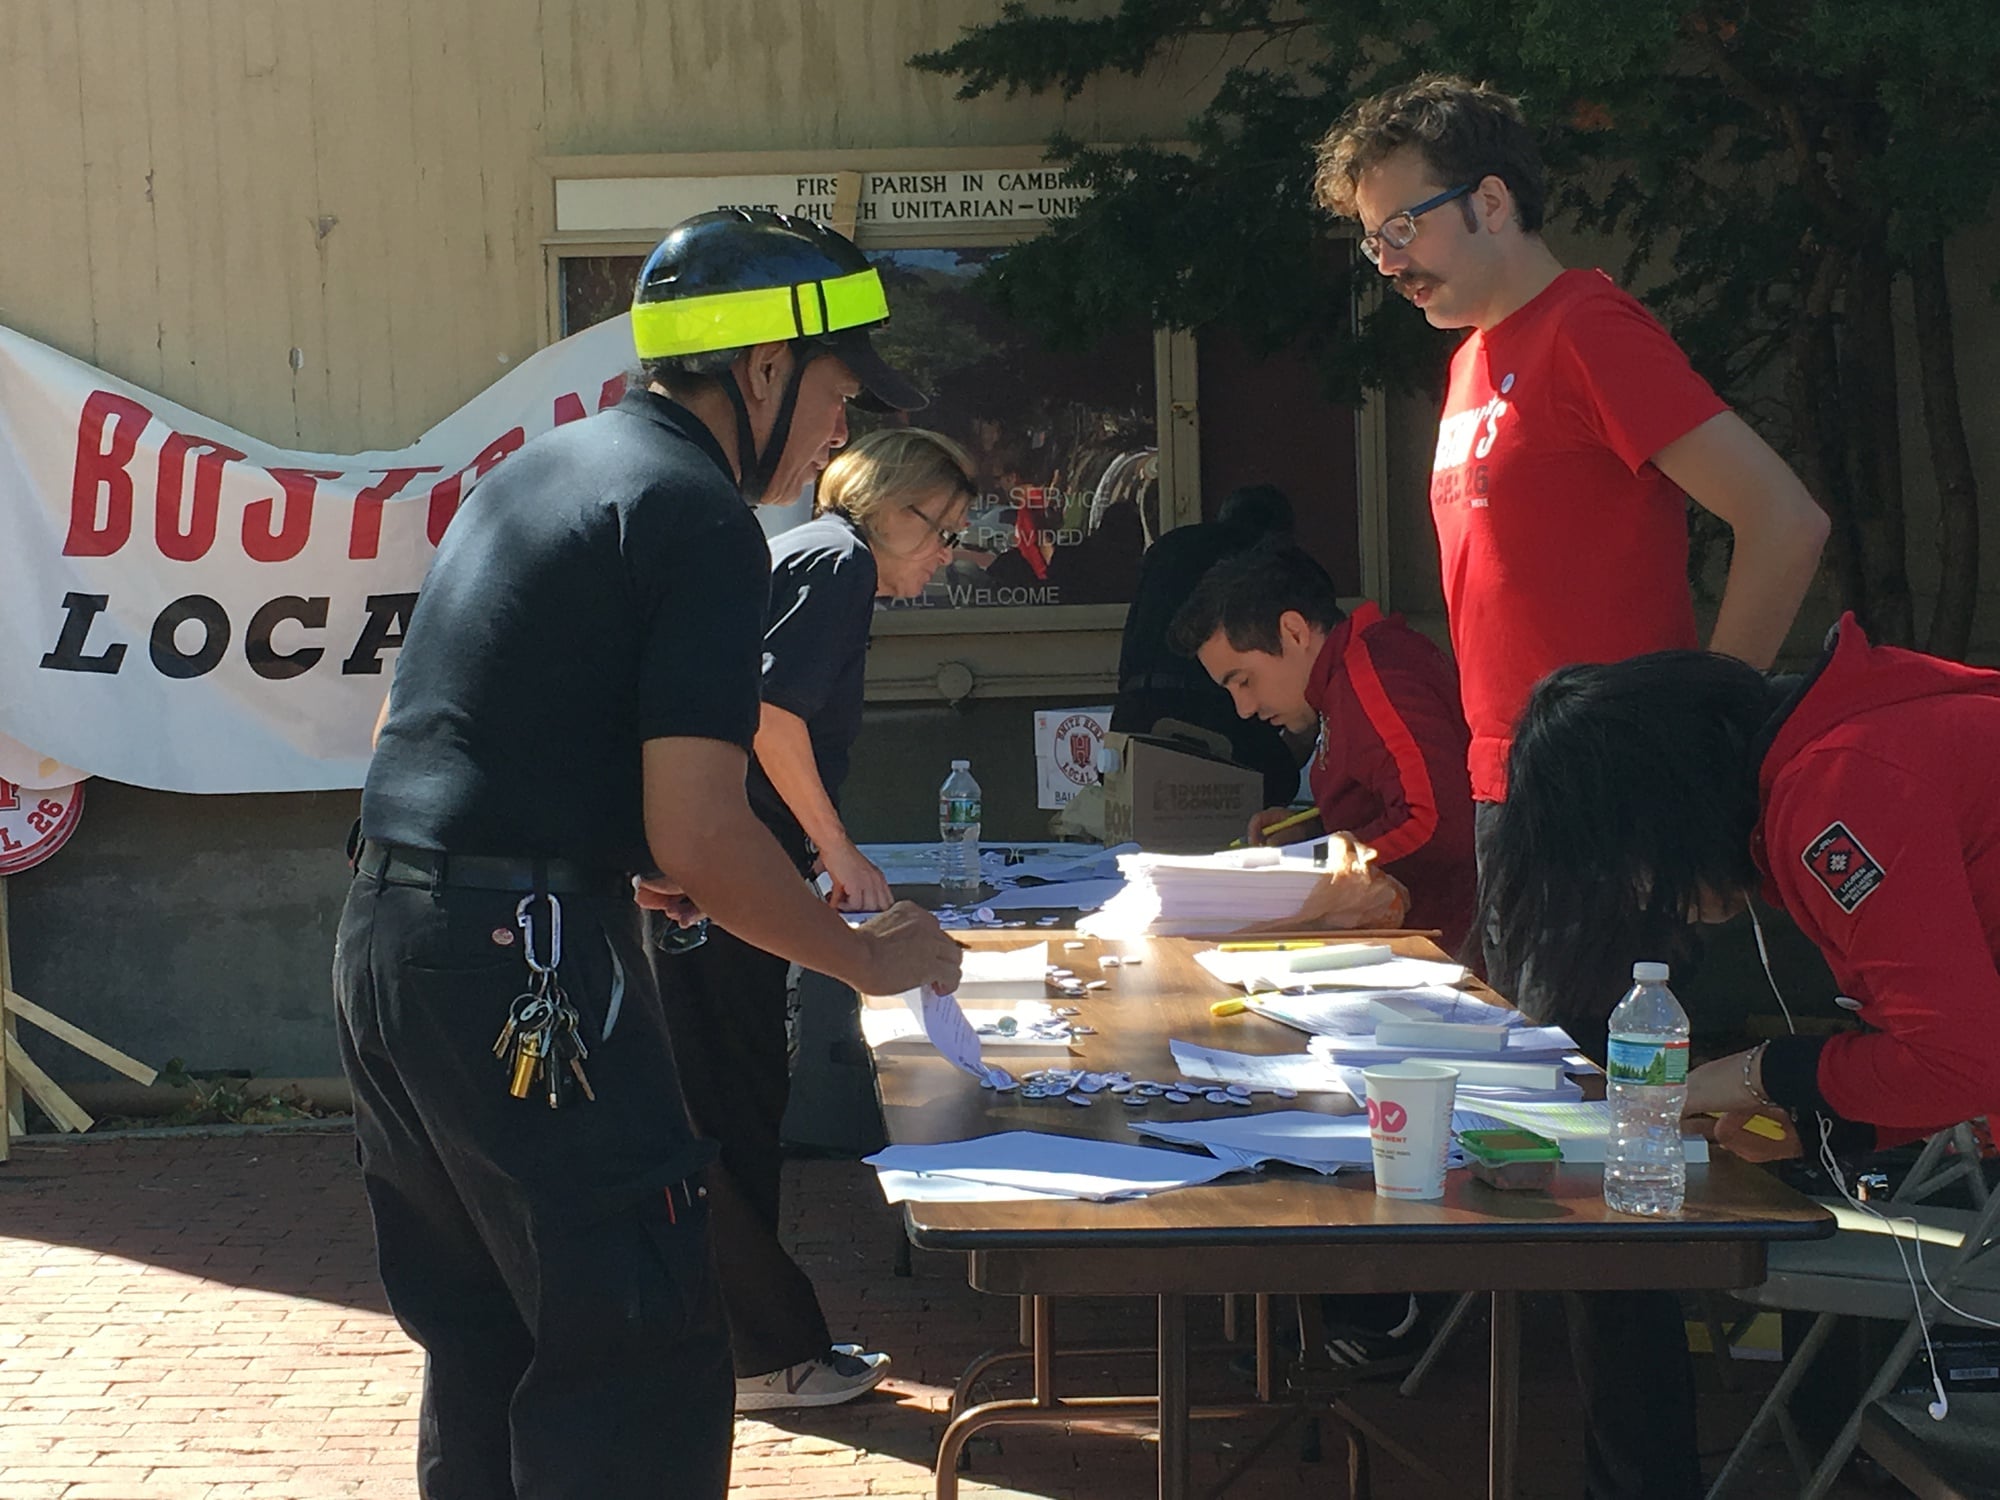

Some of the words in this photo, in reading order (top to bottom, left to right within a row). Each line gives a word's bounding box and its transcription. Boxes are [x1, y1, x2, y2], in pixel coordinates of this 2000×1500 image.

[796, 177, 838, 196] FIRS
[871, 174, 947, 194] PARISH
[963, 174, 984, 192] IN
[794, 202, 877, 220] CHUH
[63, 372, 628, 562] BOST
[978, 526, 1084, 548] PROVIDED
[946, 583, 1061, 607] WELCOME
[39, 591, 422, 680] LOCA
[1062, 762, 1093, 783] LOCAL
[27, 798, 64, 834] 26
